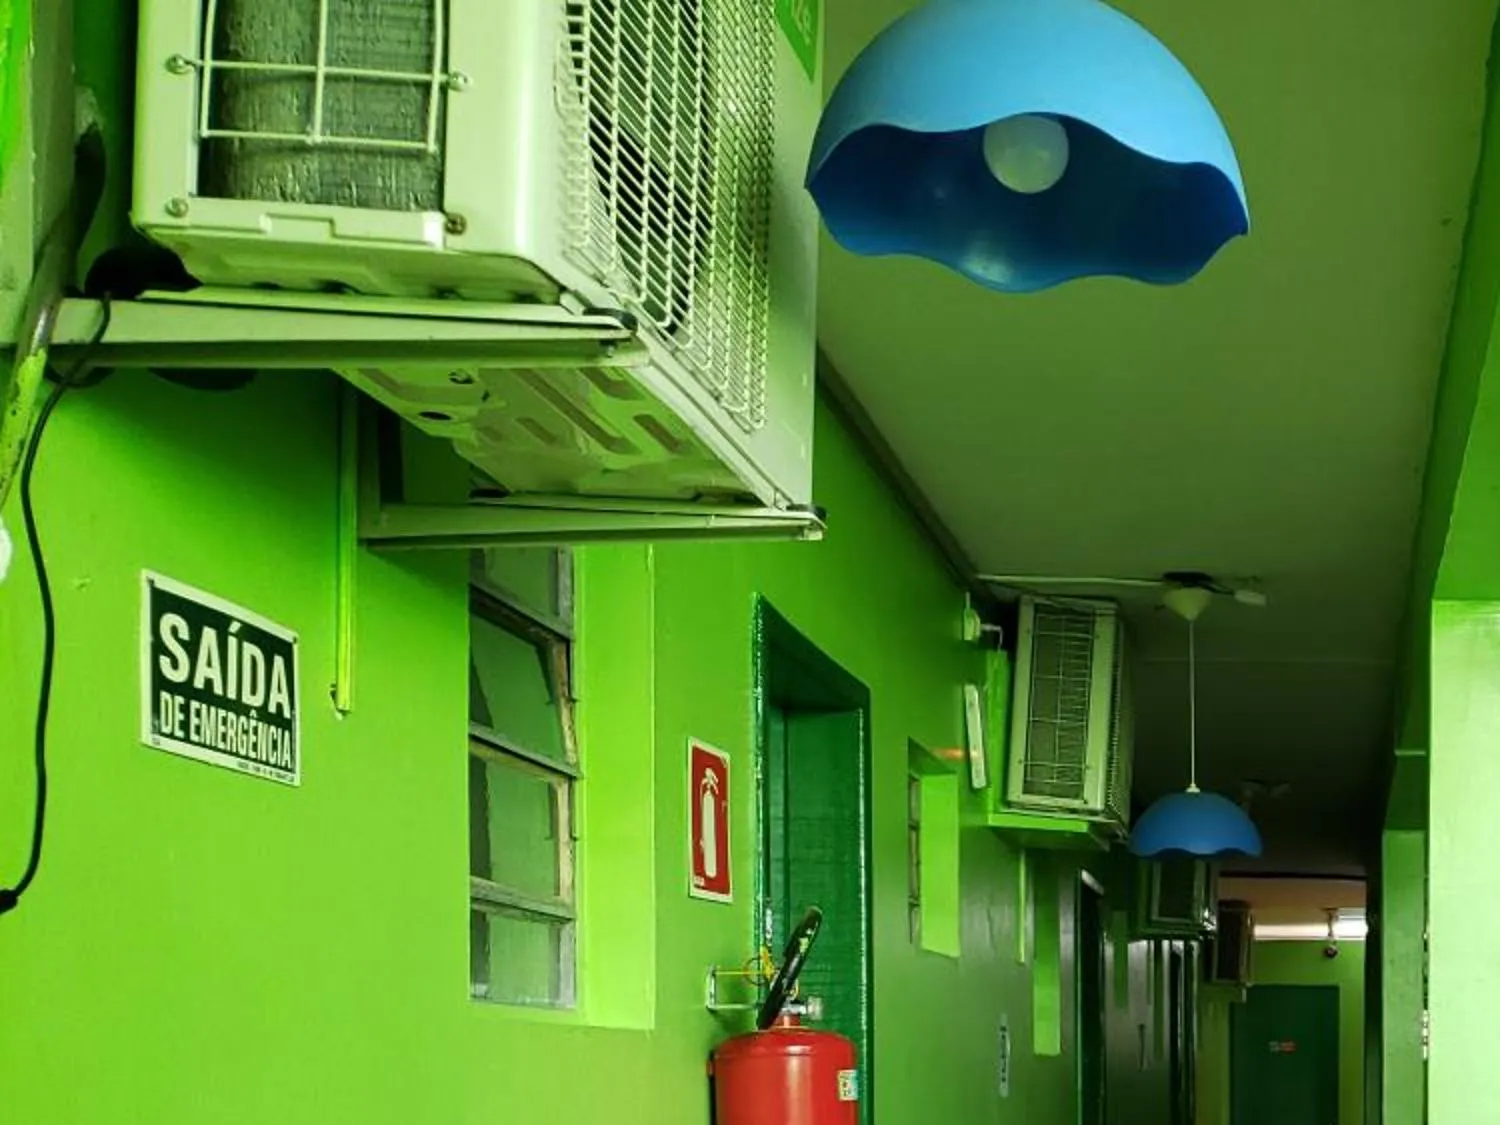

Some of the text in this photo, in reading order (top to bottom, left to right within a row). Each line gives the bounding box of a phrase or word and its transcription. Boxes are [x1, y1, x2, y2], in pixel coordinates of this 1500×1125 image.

[158, 612, 292, 720] SAÍDA
[159, 690, 292, 769] DE EMERGÊNCIA
